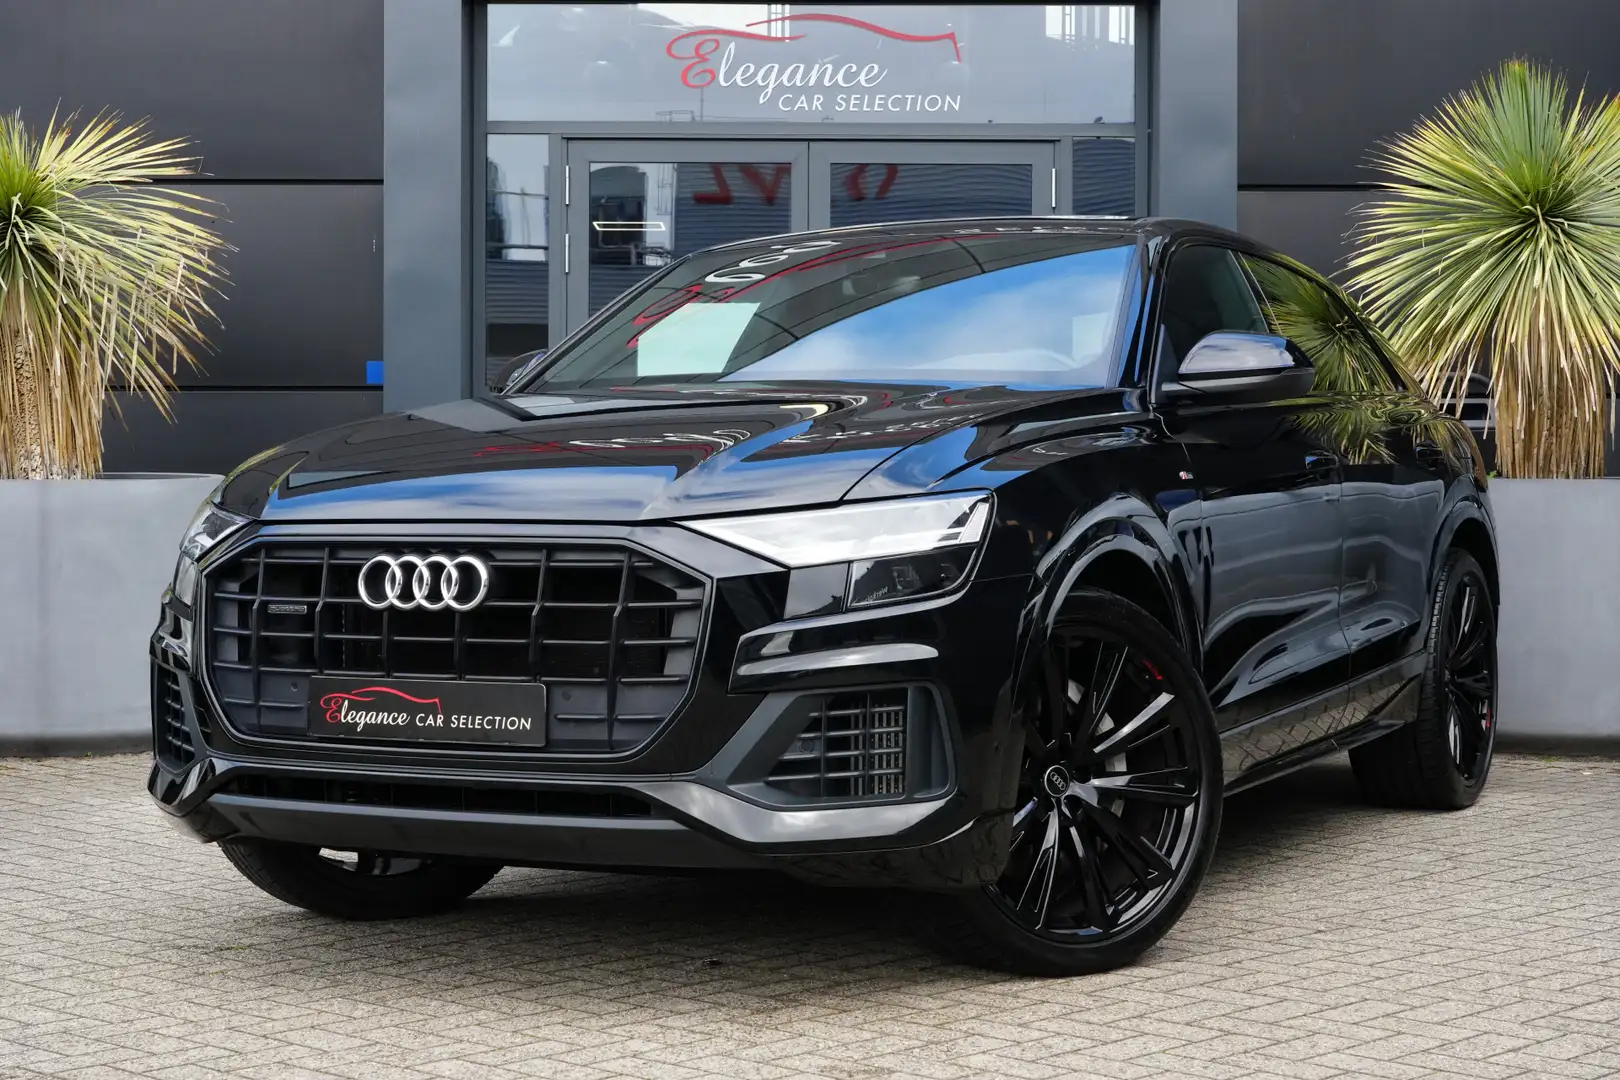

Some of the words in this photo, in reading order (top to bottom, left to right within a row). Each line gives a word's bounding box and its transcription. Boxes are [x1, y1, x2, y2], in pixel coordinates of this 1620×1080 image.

[667, 37, 888, 105] Elegance
[778, 94, 824, 111] CAR
[835, 94, 962, 112] SELECTION
[321, 697, 411, 732] Elegance
[415, 713, 444, 727] CAR
[450, 714, 532, 730] SELECTION
